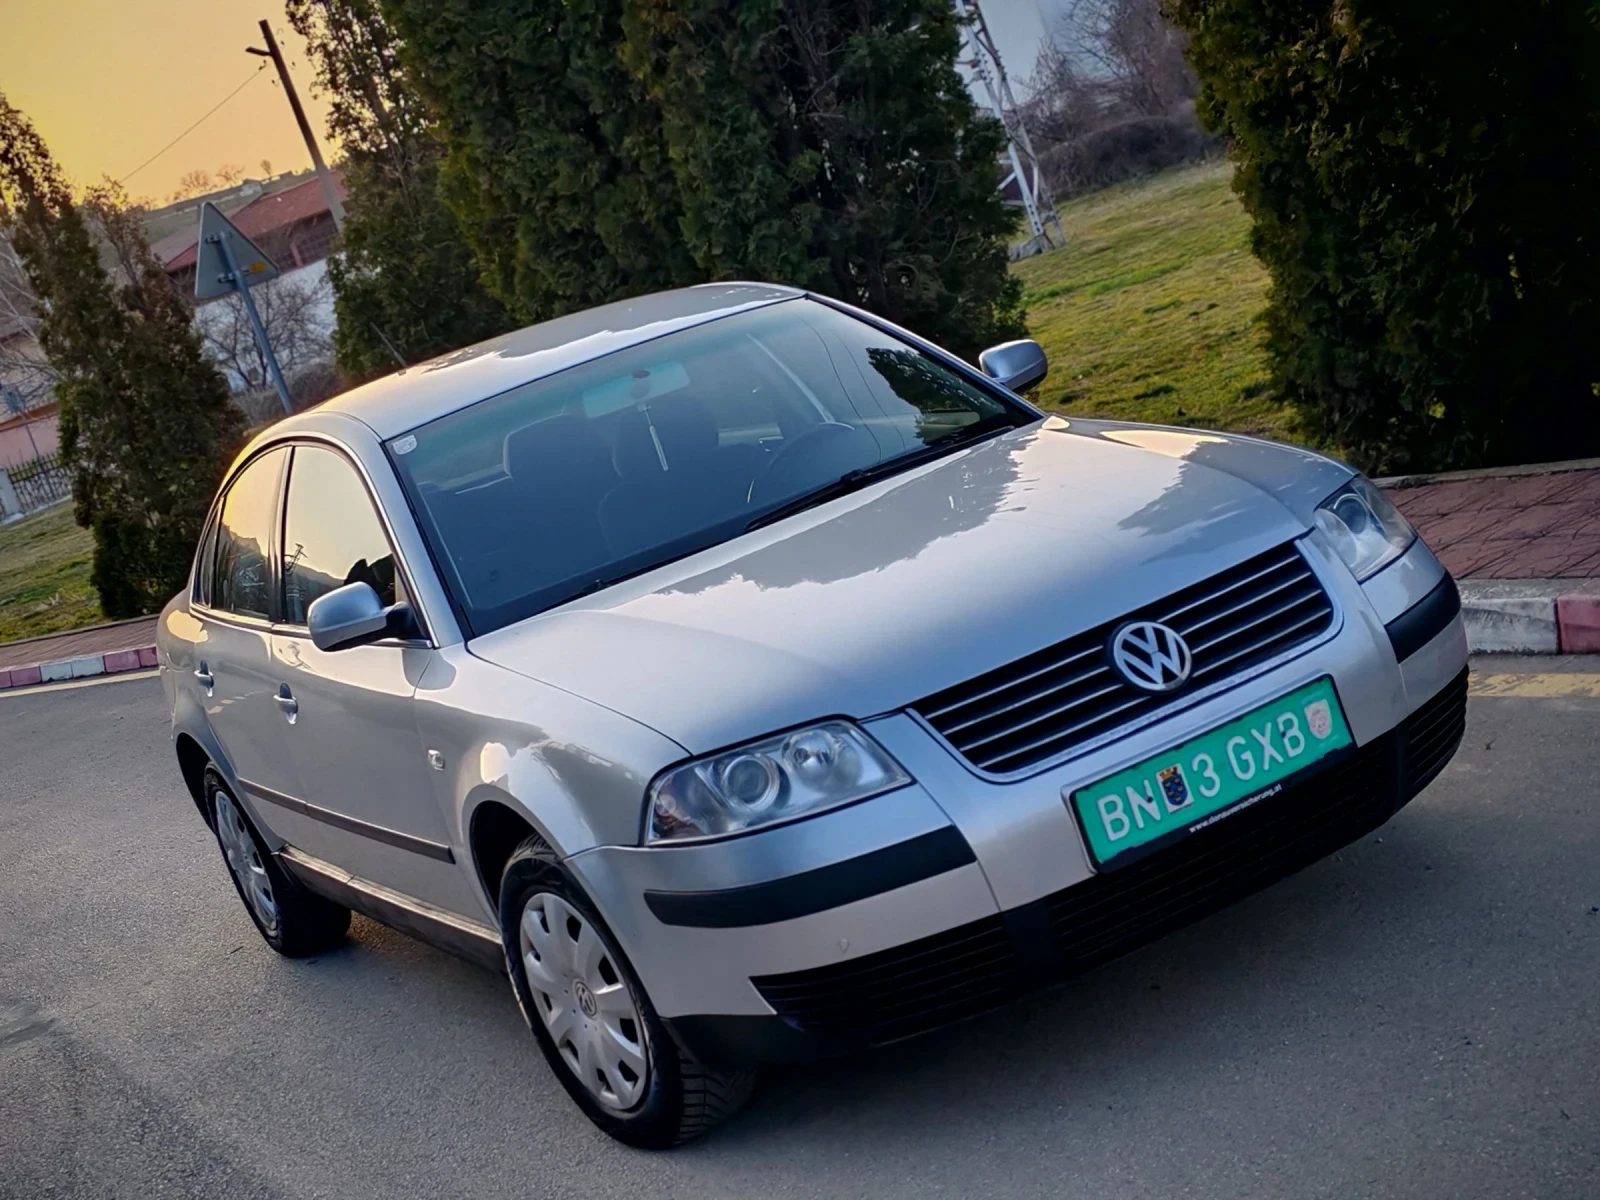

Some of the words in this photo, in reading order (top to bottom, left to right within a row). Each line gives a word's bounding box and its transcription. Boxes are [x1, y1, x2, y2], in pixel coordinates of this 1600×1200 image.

[1113, 621, 1191, 690] VW
[1096, 779, 1161, 842] BN
[1191, 753, 1221, 798] 3
[1226, 711, 1306, 781] GXB
